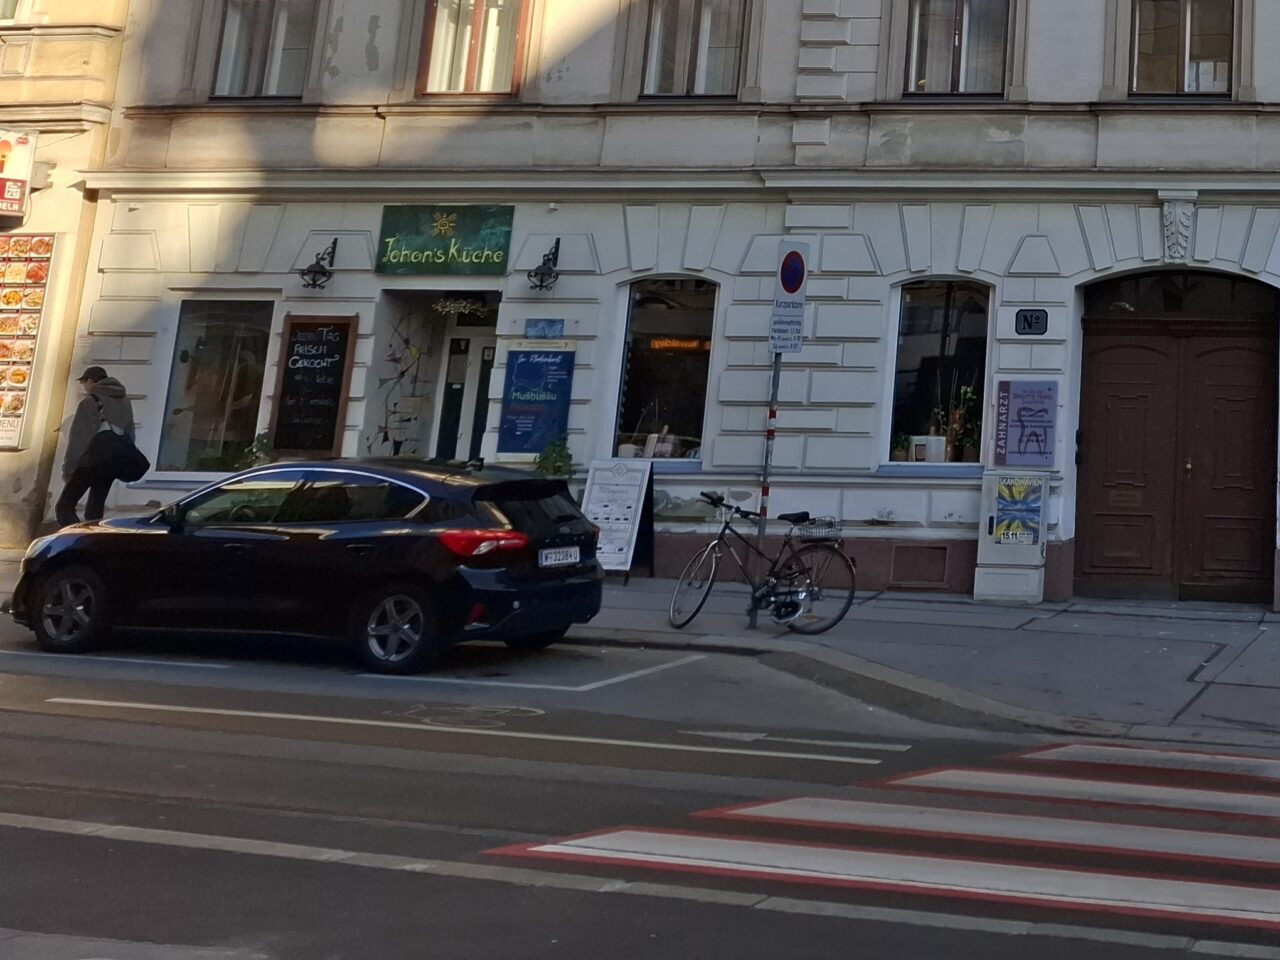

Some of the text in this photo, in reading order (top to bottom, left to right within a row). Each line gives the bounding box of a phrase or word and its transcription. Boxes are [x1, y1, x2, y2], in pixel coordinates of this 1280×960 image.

[448, 238, 504, 263] Küche
[294, 343, 328, 355] FRISCH
[288, 355, 340, 369] GEKOCHT
[996, 392, 1009, 455] ZAHNARZT
